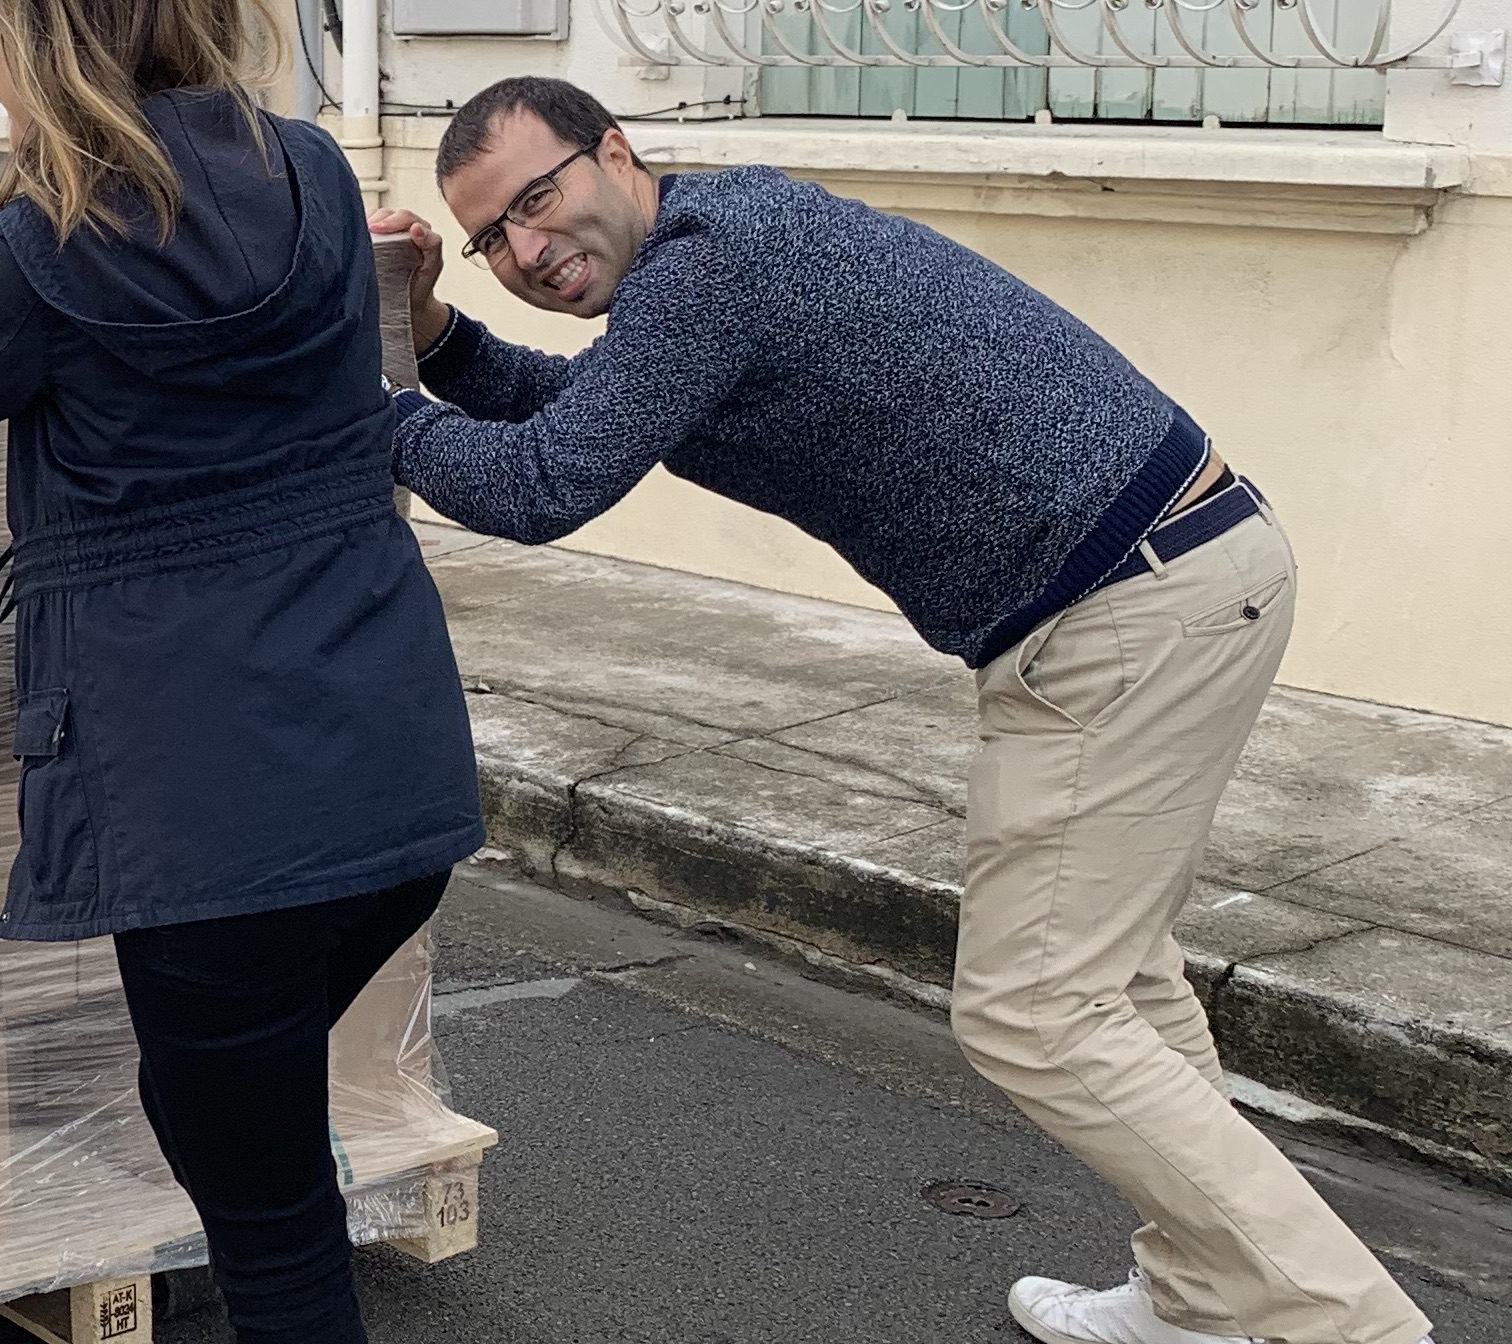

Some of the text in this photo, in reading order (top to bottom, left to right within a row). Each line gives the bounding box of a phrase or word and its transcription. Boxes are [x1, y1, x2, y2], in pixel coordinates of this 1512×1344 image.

[442, 1181, 465, 1205] 73
[436, 1199, 470, 1227] 103
[116, 1315, 130, 1331] HT
